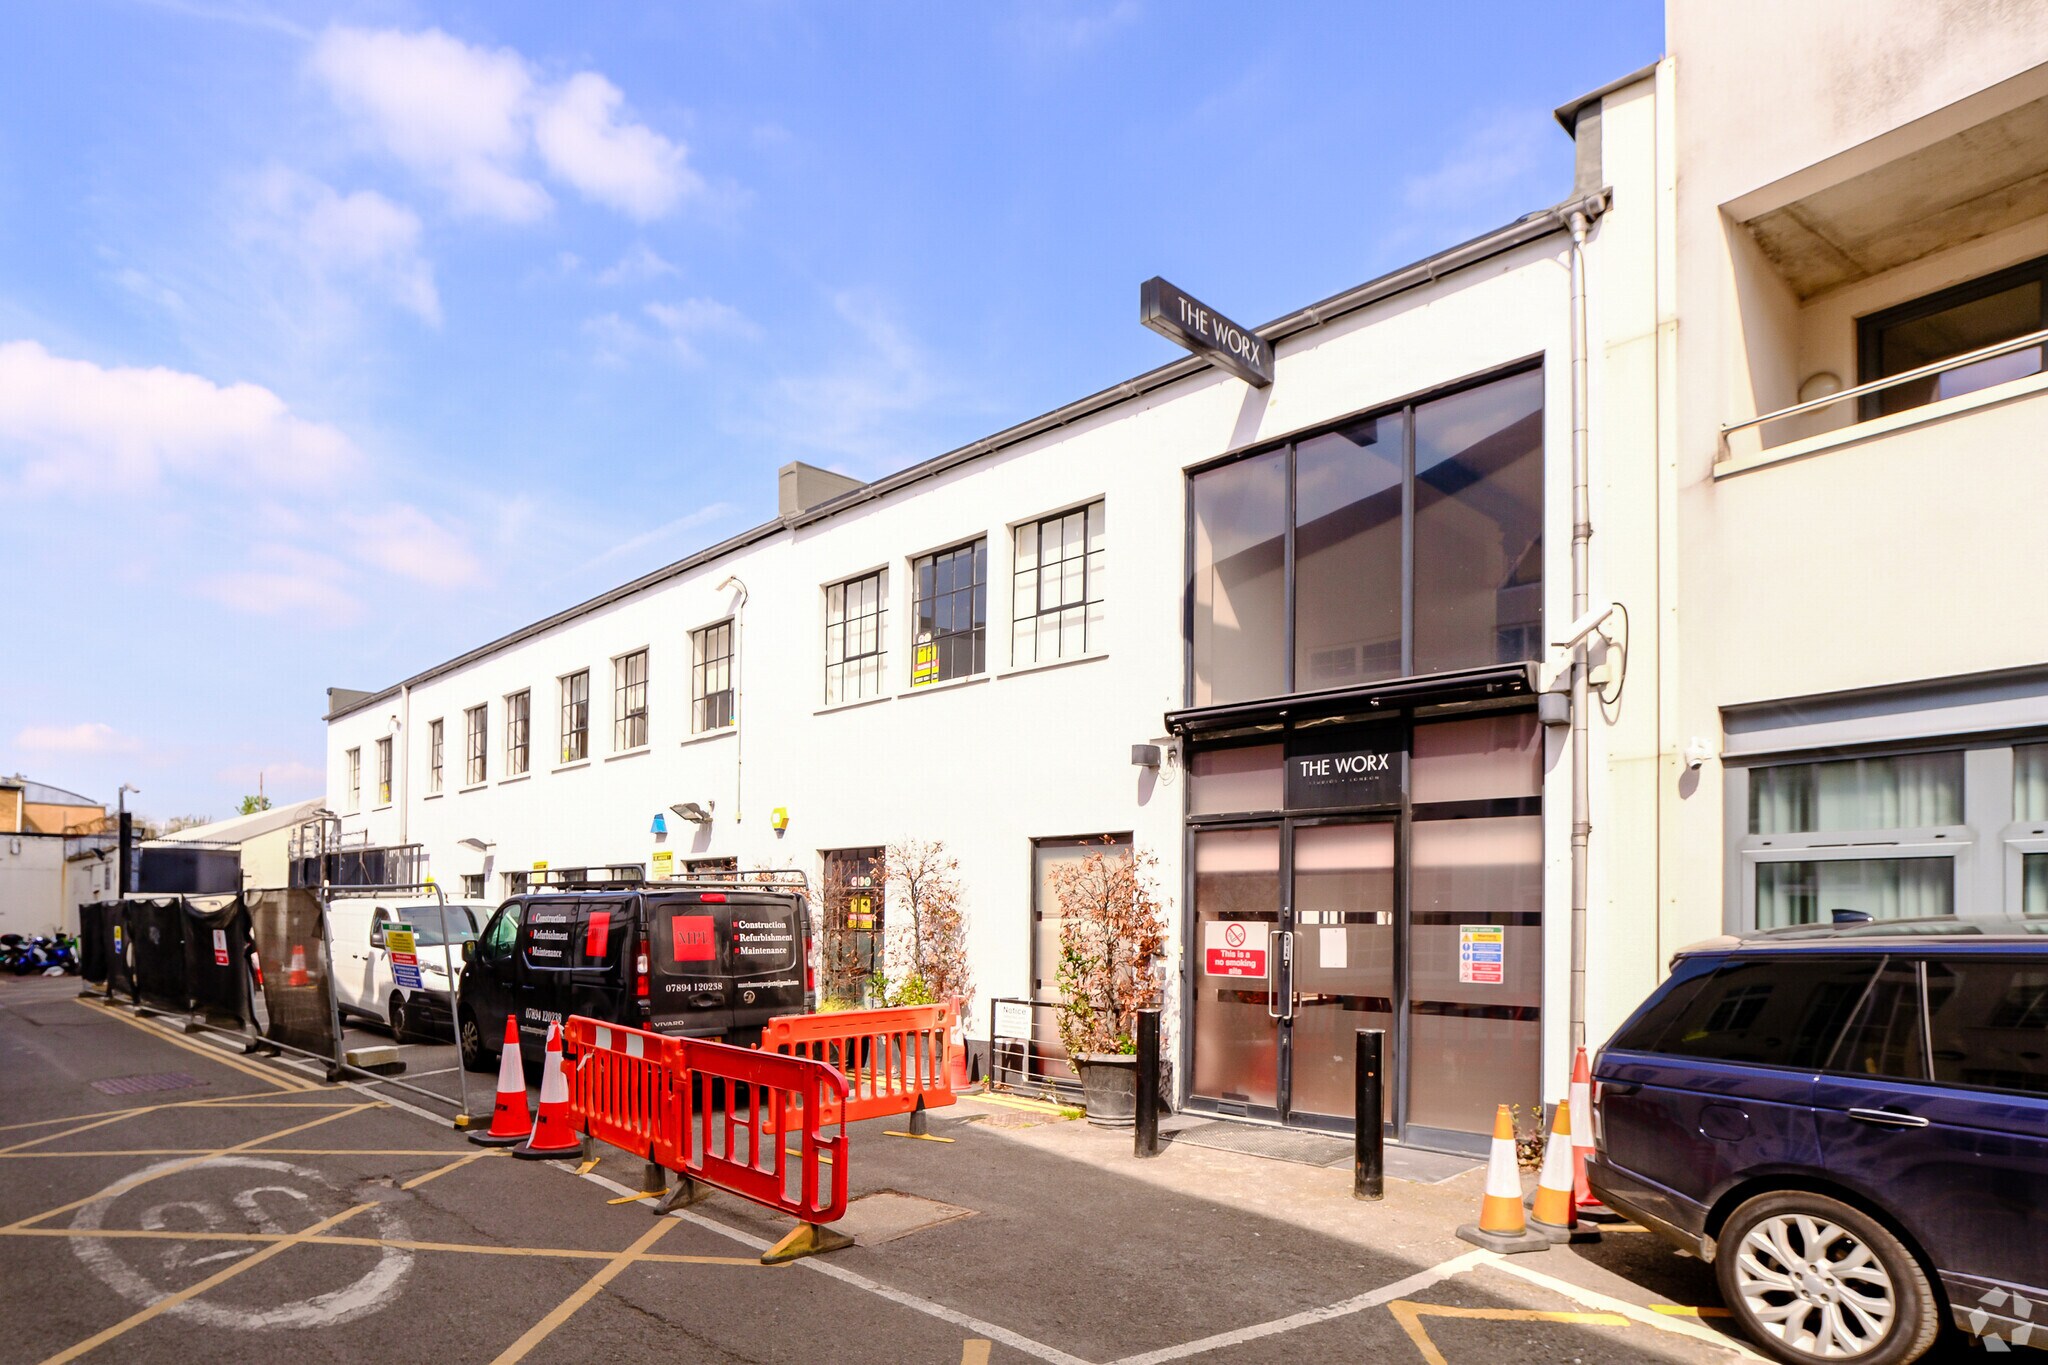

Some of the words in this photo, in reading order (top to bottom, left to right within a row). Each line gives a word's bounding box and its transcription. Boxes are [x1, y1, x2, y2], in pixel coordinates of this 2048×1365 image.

[1178, 296, 1208, 335] THE
[1212, 318, 1260, 366] WORX
[1300, 759, 1330, 777] THE
[1335, 753, 1389, 774] WORX
[535, 912, 567, 923] Construction
[738, 920, 787, 929] Construction
[533, 929, 568, 941] Refurbishment
[739, 933, 793, 942] Refurbishment
[531, 946, 562, 958] Maintenance
[740, 947, 787, 955] Maintenance
[1221, 949, 1236, 958] This
[1237, 950, 1244, 958] is
[1225, 959, 1256, 969] smoking
[1228, 967, 1242, 975] site
[665, 983, 691, 992] 07894
[694, 982, 723, 991] 120238
[1003, 1006, 1027, 1015] Notice
[654, 1020, 684, 1028] VIVARO
